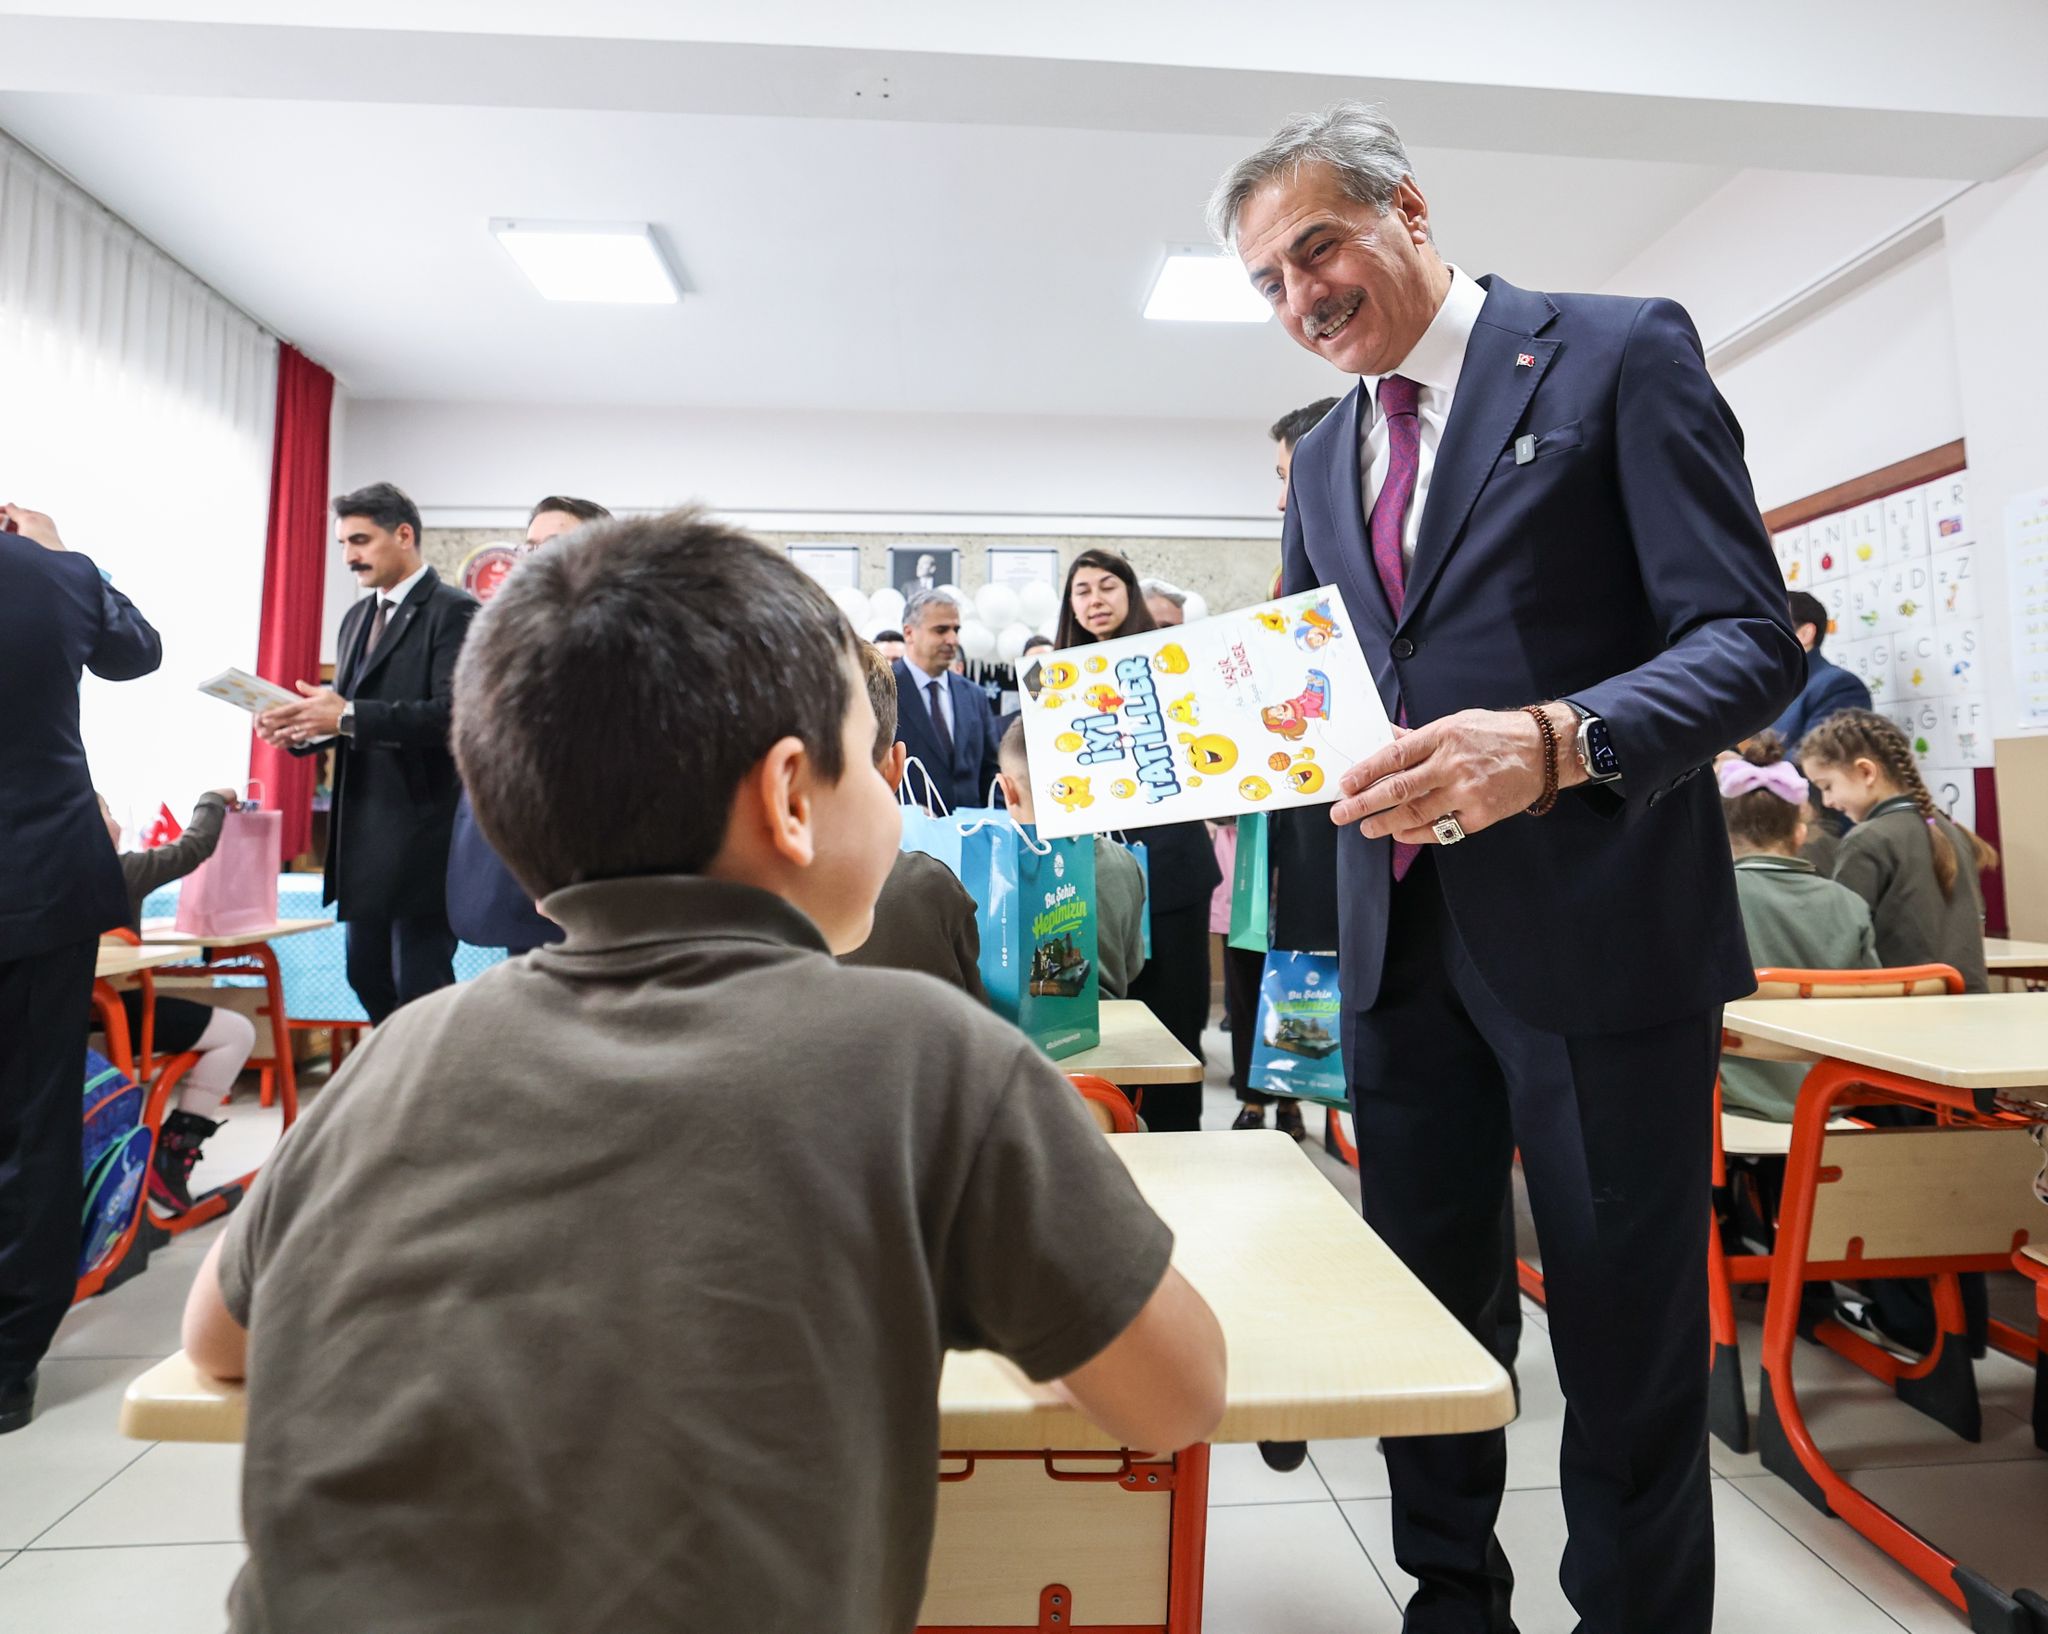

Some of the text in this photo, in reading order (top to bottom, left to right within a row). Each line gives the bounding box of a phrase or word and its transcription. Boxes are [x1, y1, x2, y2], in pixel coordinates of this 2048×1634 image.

[1952, 484, 1964, 504] R
[1905, 499, 1916, 520] T
[1826, 524, 1840, 543] N
[1864, 515, 1876, 532] L
[1894, 568, 1926, 593] d D
[1938, 556, 1970, 583] z Z
[1869, 578, 1882, 598] Y
[1873, 645, 1888, 665] G
[1915, 636, 1931, 658] C
[1920, 703, 1938, 730] Ğ
[1969, 703, 1981, 725] F
[1071, 713, 1125, 765] İYİ
[1115, 655, 1181, 804] TATİLLER
[1045, 883, 1076, 909] Bu Şehir
[1032, 896, 1087, 940] Hepimizin
[1288, 990, 1302, 1000] Bu
